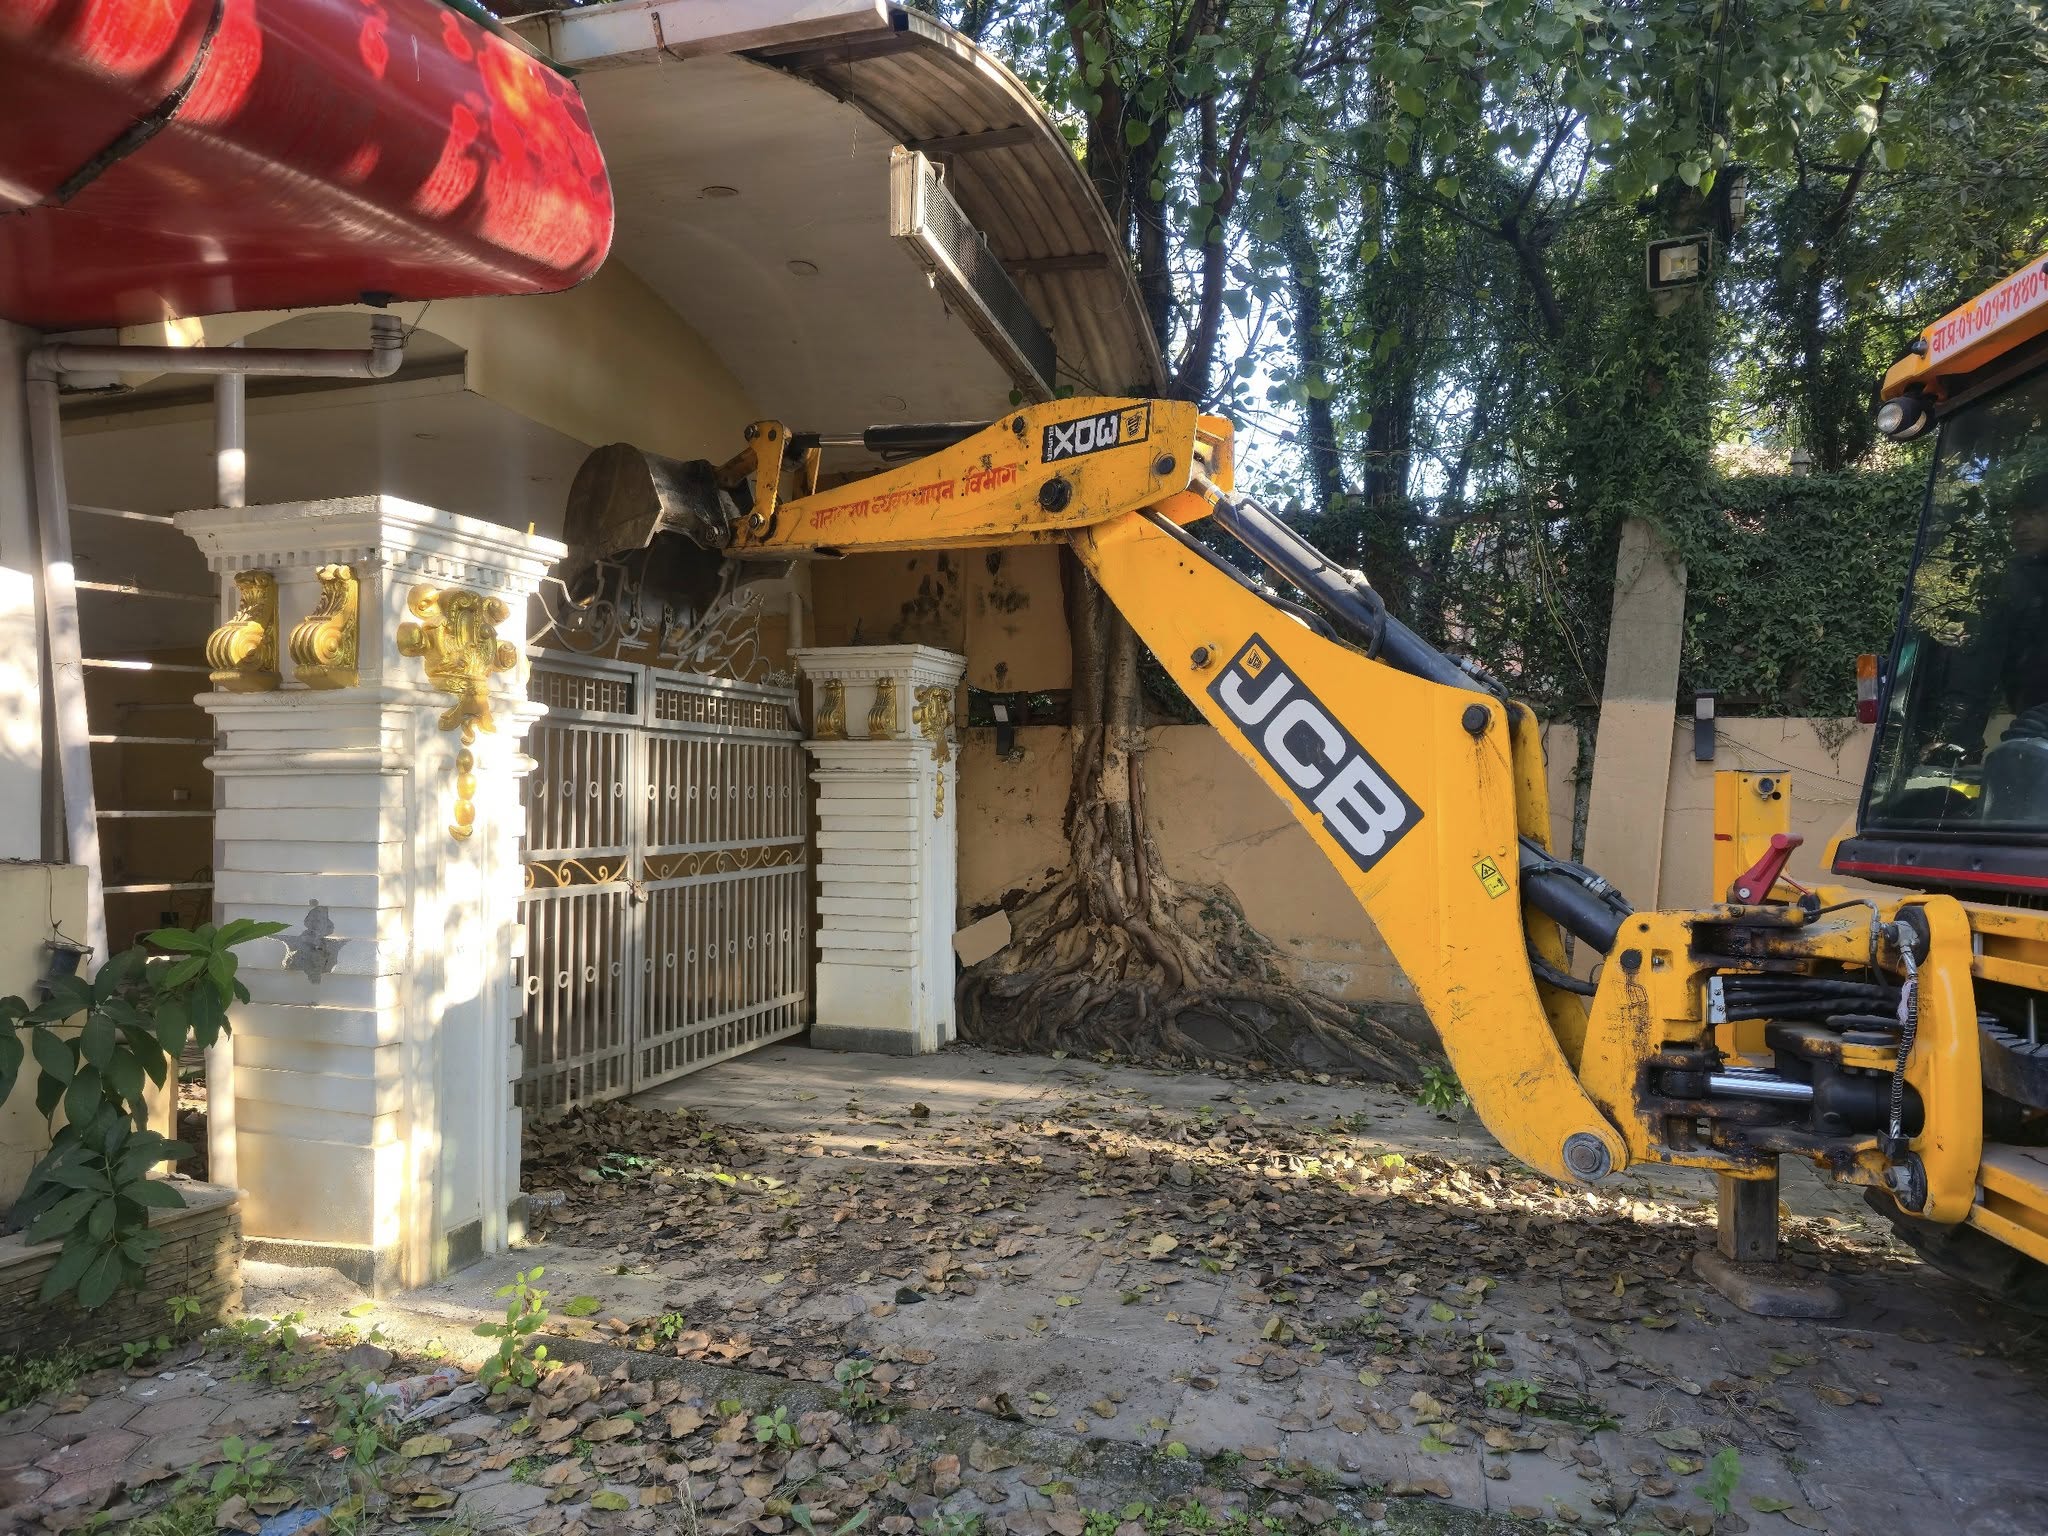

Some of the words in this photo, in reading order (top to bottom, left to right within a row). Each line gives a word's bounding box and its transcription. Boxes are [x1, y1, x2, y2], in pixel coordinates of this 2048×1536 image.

[1053, 415, 1118, 459] 3DX
[964, 462, 1017, 496] विभाग
[1219, 669, 1406, 856] JCB
